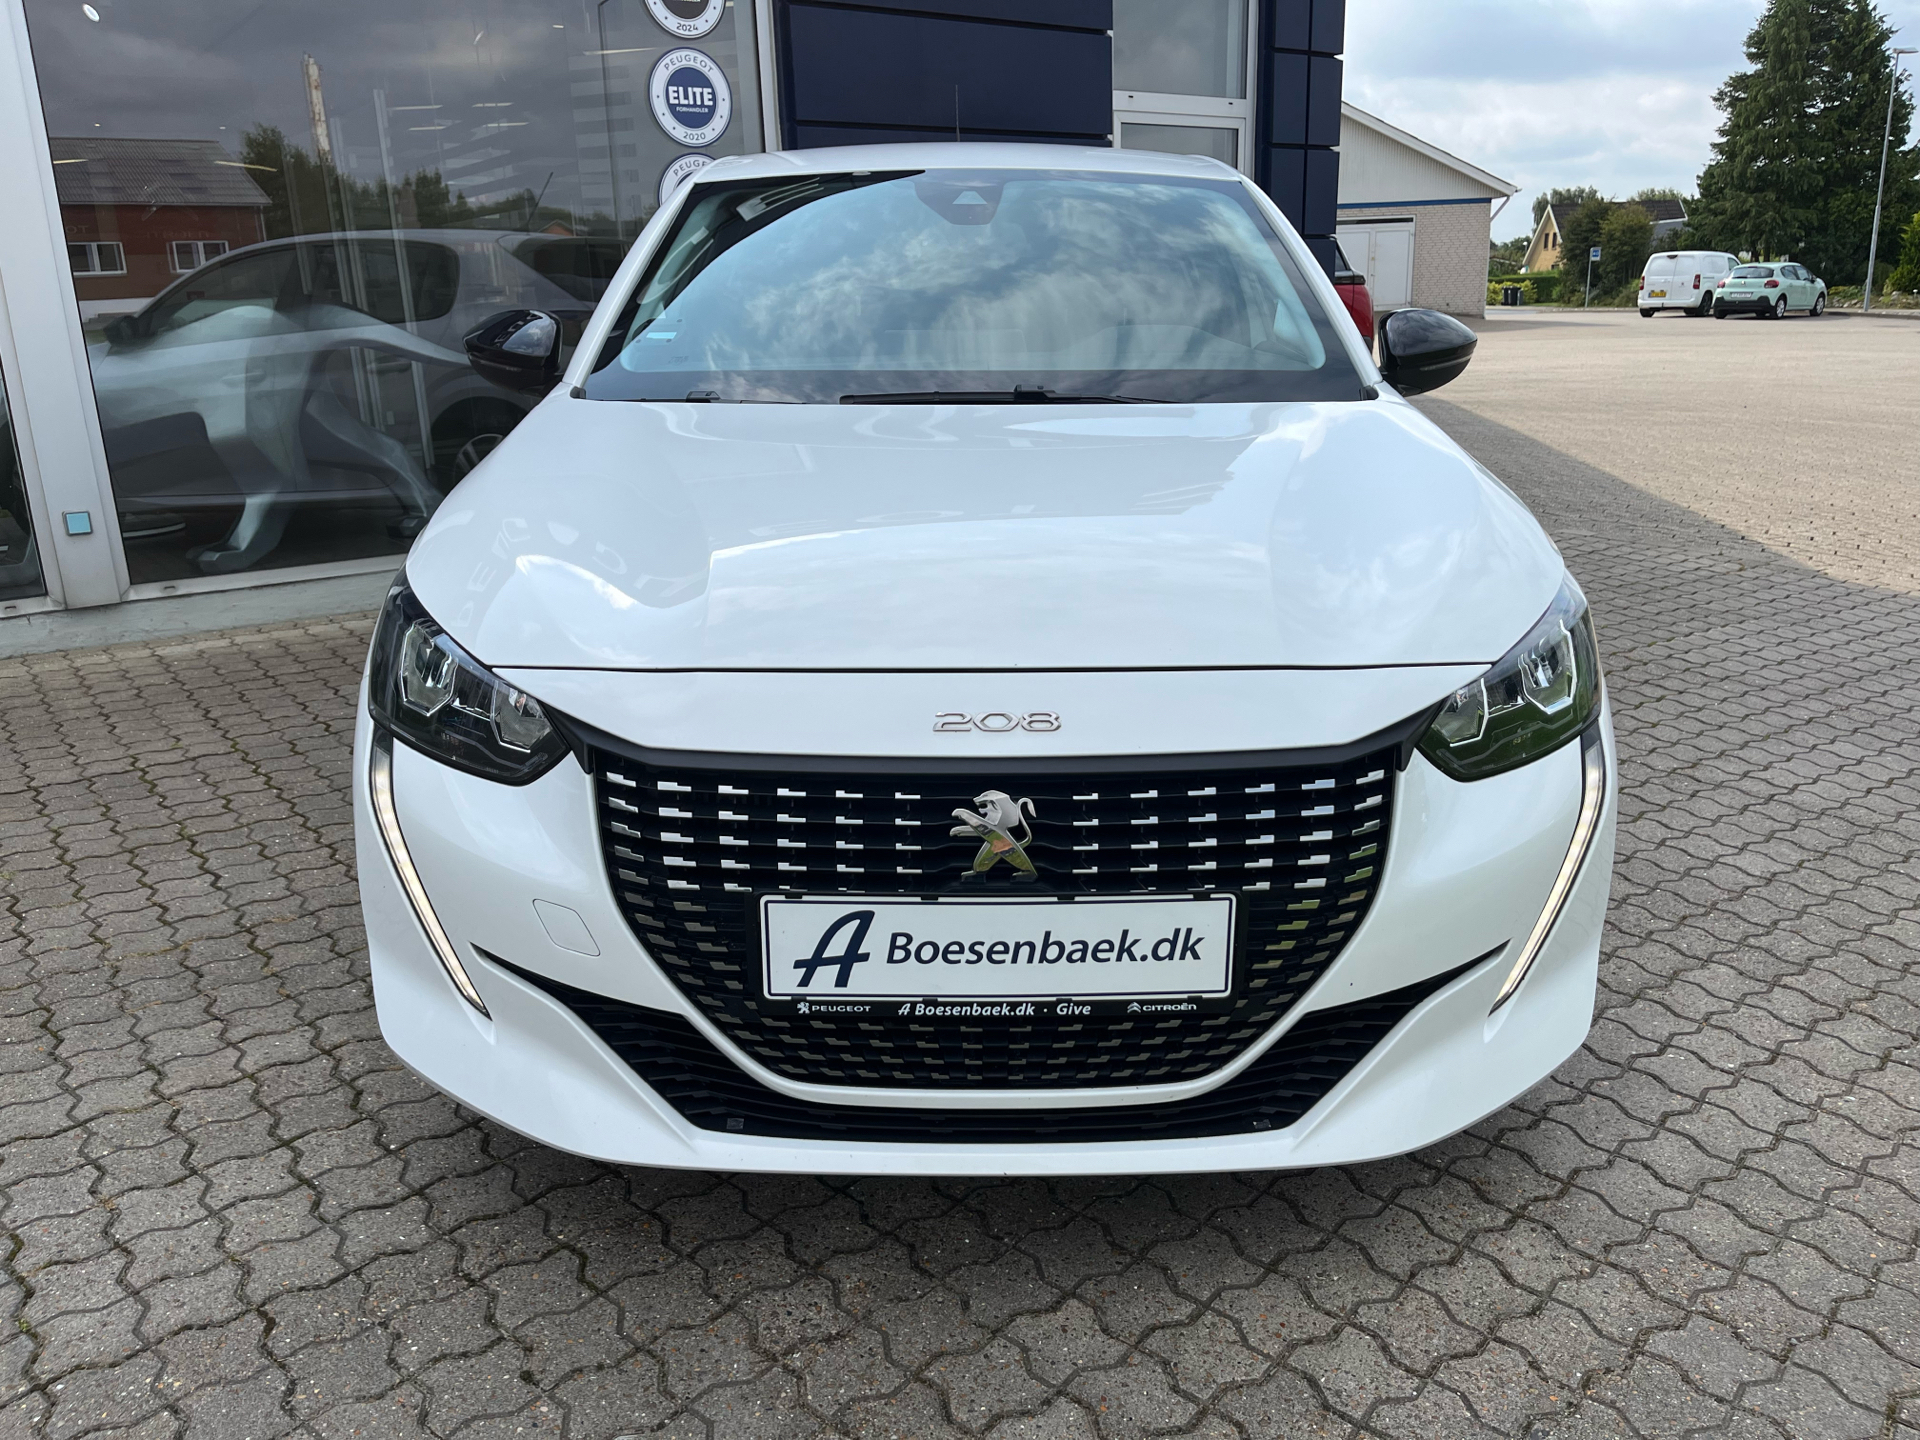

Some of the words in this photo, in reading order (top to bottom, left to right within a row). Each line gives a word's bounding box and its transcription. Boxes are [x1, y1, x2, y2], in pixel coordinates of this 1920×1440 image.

[676, 22, 699, 32] 2024
[664, 54, 714, 73] PEUGEOT
[668, 86, 713, 106] ELITE
[683, 131, 706, 141] 2020
[673, 159, 708, 177] PEUGE
[933, 711, 1061, 732] 208
[886, 927, 1205, 965] Boesenbaek.dk
[811, 1005, 871, 1013] PEUGEOT
[915, 1003, 1035, 1016] Boesenbaek.dk
[1056, 1003, 1091, 1015] Give
